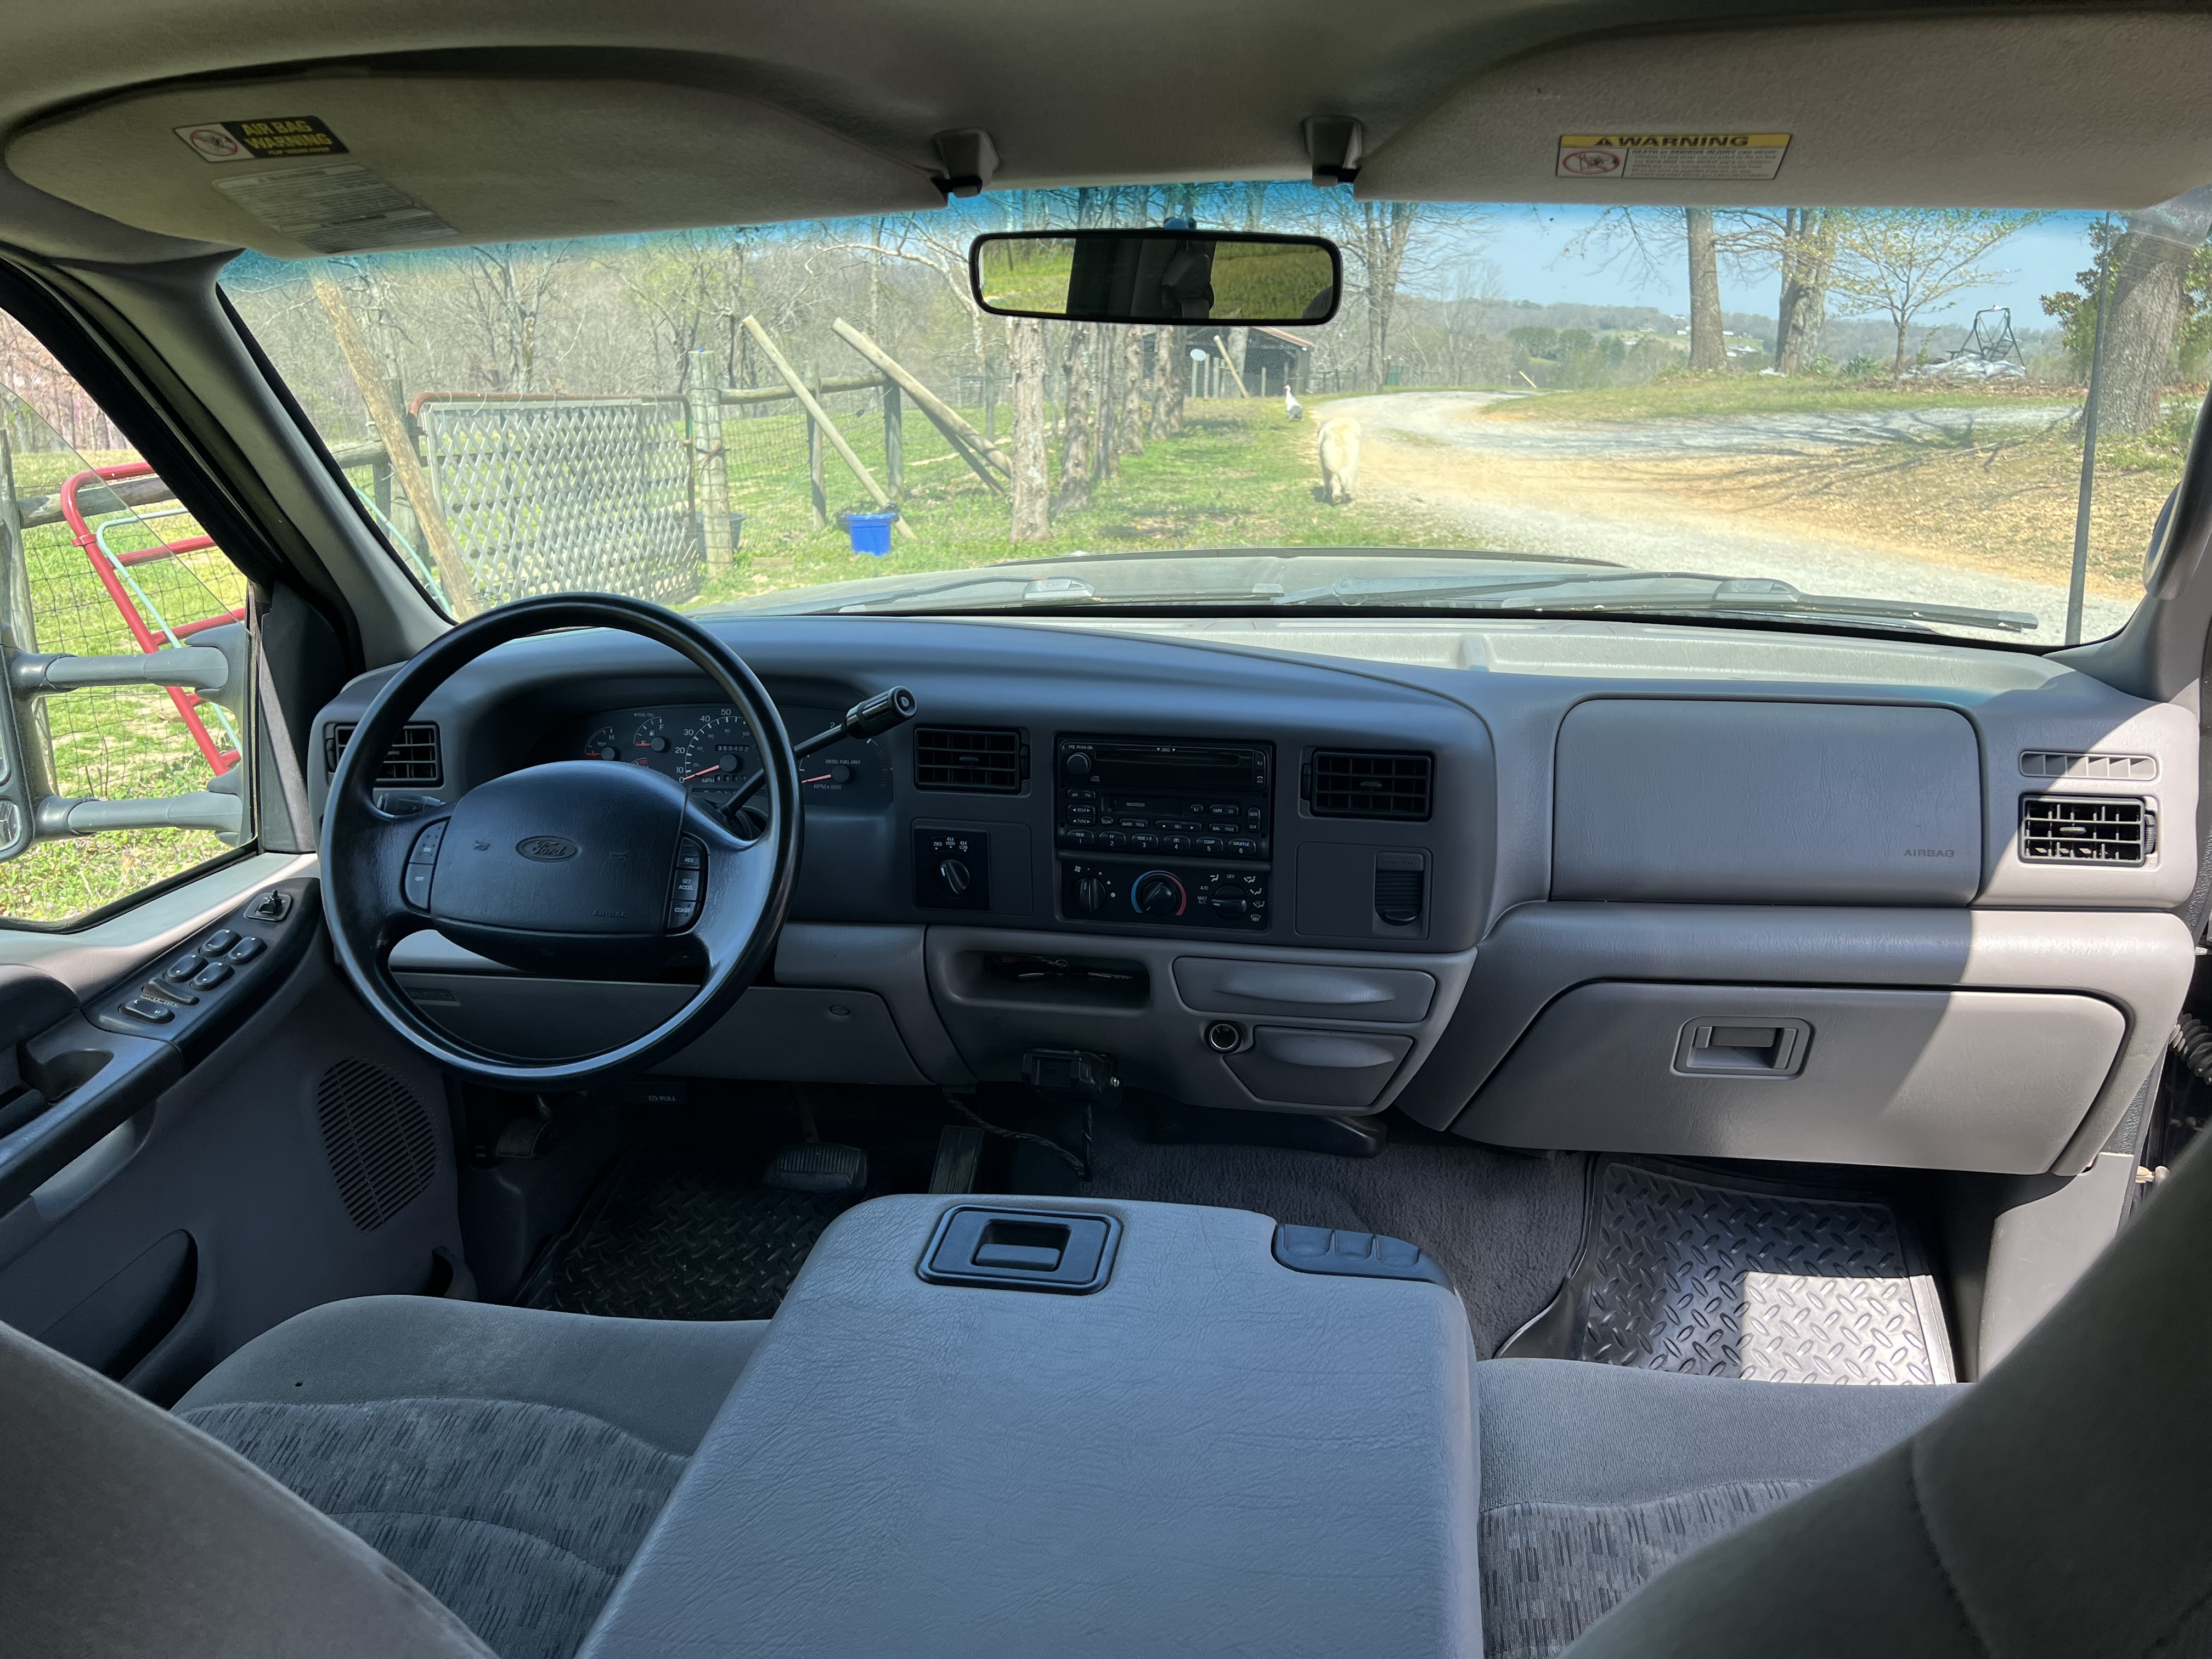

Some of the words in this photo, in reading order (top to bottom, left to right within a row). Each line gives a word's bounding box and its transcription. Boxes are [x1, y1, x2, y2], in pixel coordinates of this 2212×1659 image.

[241, 122, 275, 136] AIR
[270, 120, 313, 134] BAG
[244, 133, 334, 149] WARNING
[1618, 137, 1748, 147] WARNING
[533, 842, 567, 856] Ford
[1904, 849, 1954, 857] AIRBAG
[592, 910, 629, 919] AIRBAG
